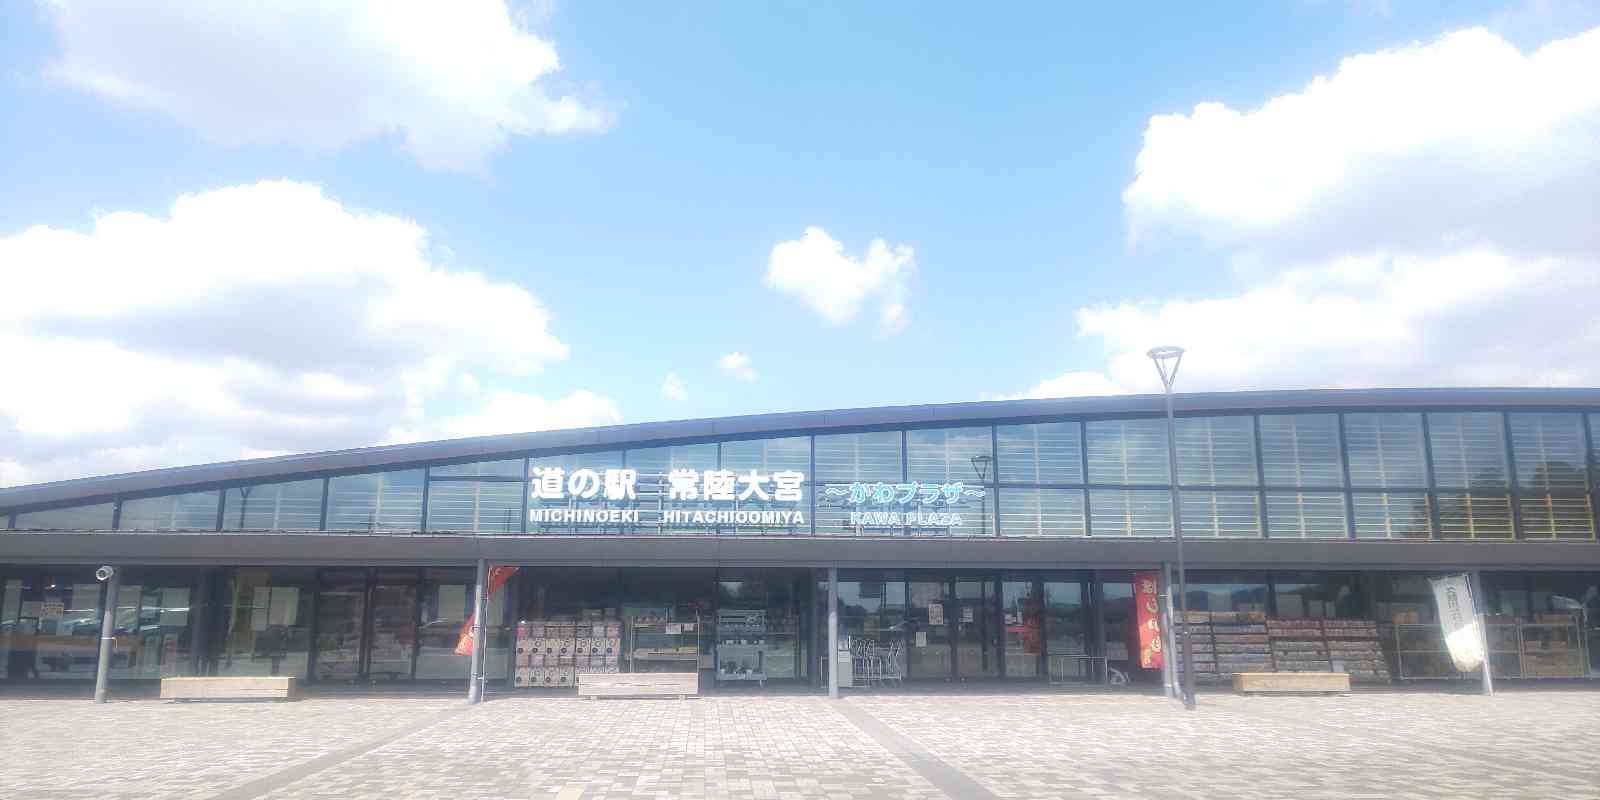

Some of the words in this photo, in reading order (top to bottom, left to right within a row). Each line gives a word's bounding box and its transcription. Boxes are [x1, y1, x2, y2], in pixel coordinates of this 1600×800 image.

[530, 467, 637, 501] 道の駅
[668, 468, 805, 501] 常陸大宮
[529, 509, 639, 523] MICHINOEKI
[663, 510, 805, 525] HITACHIOOMIYA
[850, 511, 902, 526] KAWA
[905, 511, 962, 526] PLAZA
